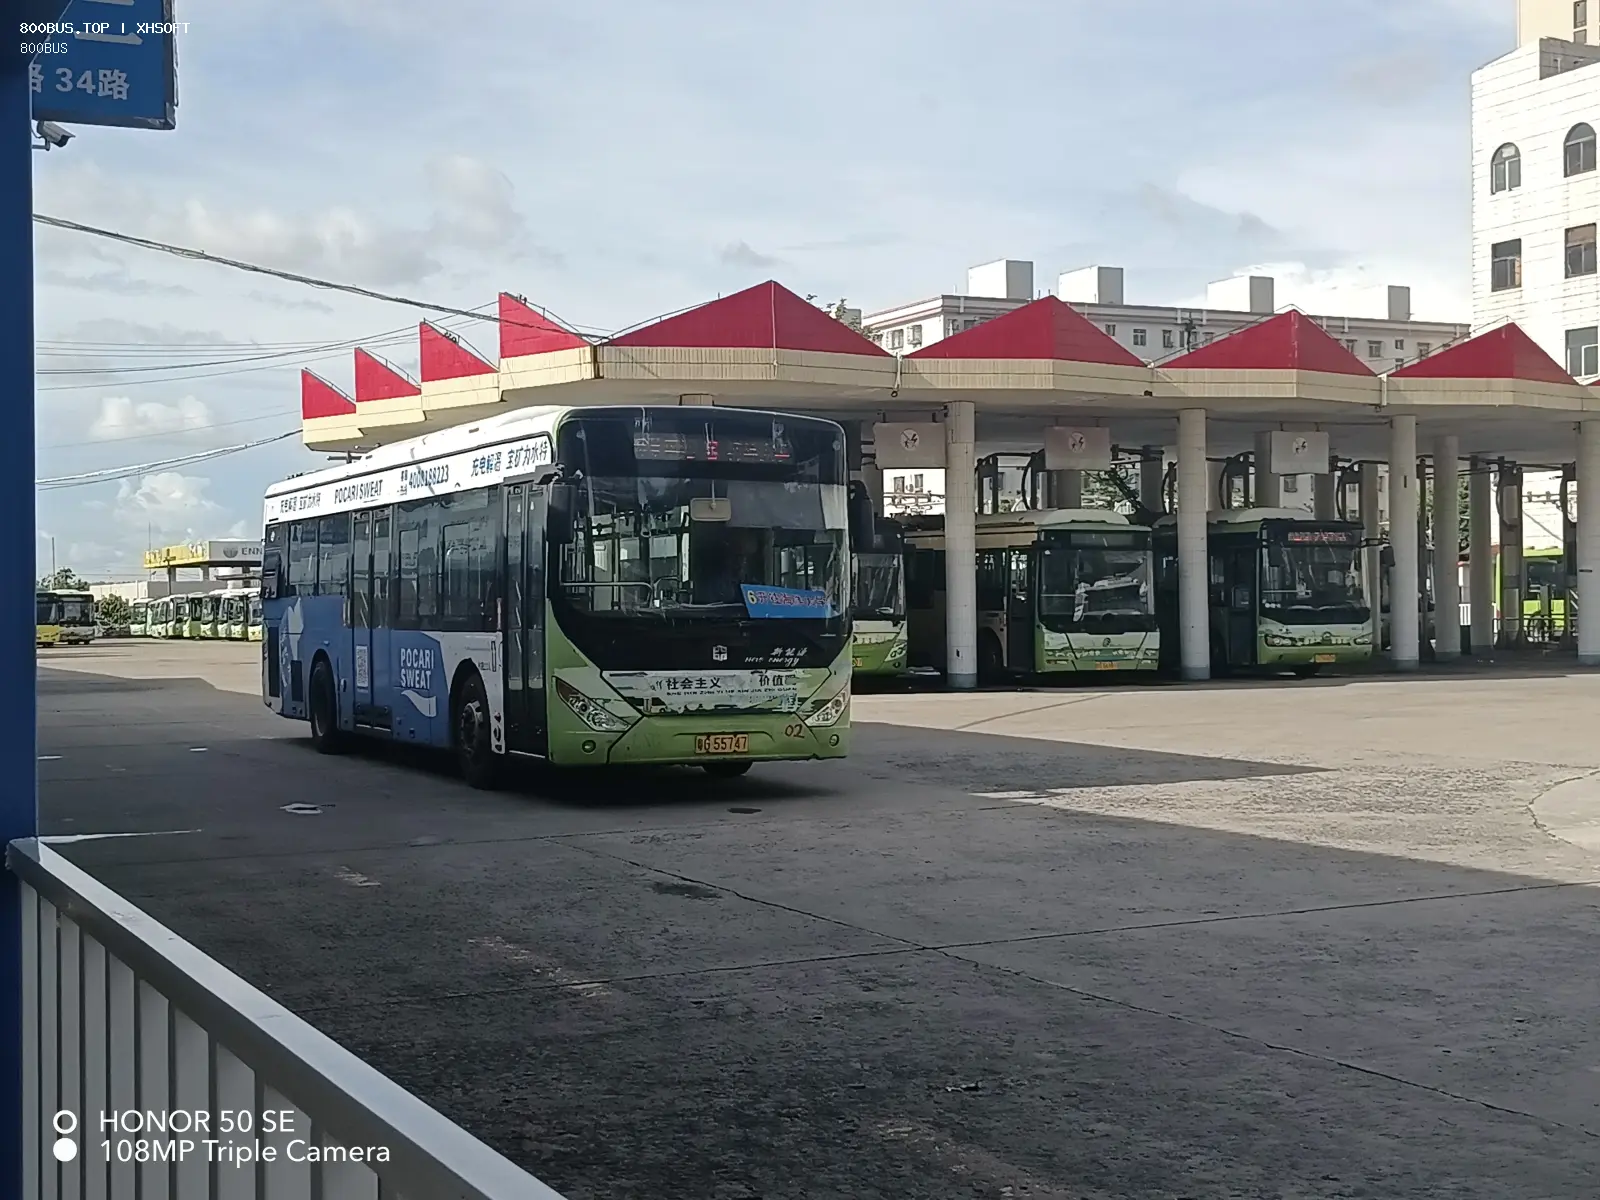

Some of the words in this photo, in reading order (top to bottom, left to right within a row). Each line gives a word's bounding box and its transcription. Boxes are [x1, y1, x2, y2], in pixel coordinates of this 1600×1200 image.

[55, 67, 130, 100] 34路
[506, 440, 548, 470] 宝矿力水特
[334, 484, 359, 504] POCARI
[359, 479, 383, 500] SWEAT
[400, 647, 434, 669] POCARI
[400, 669, 431, 690] SWEAT
[665, 677, 722, 690] 社会主义
[785, 723, 806, 739] 02
